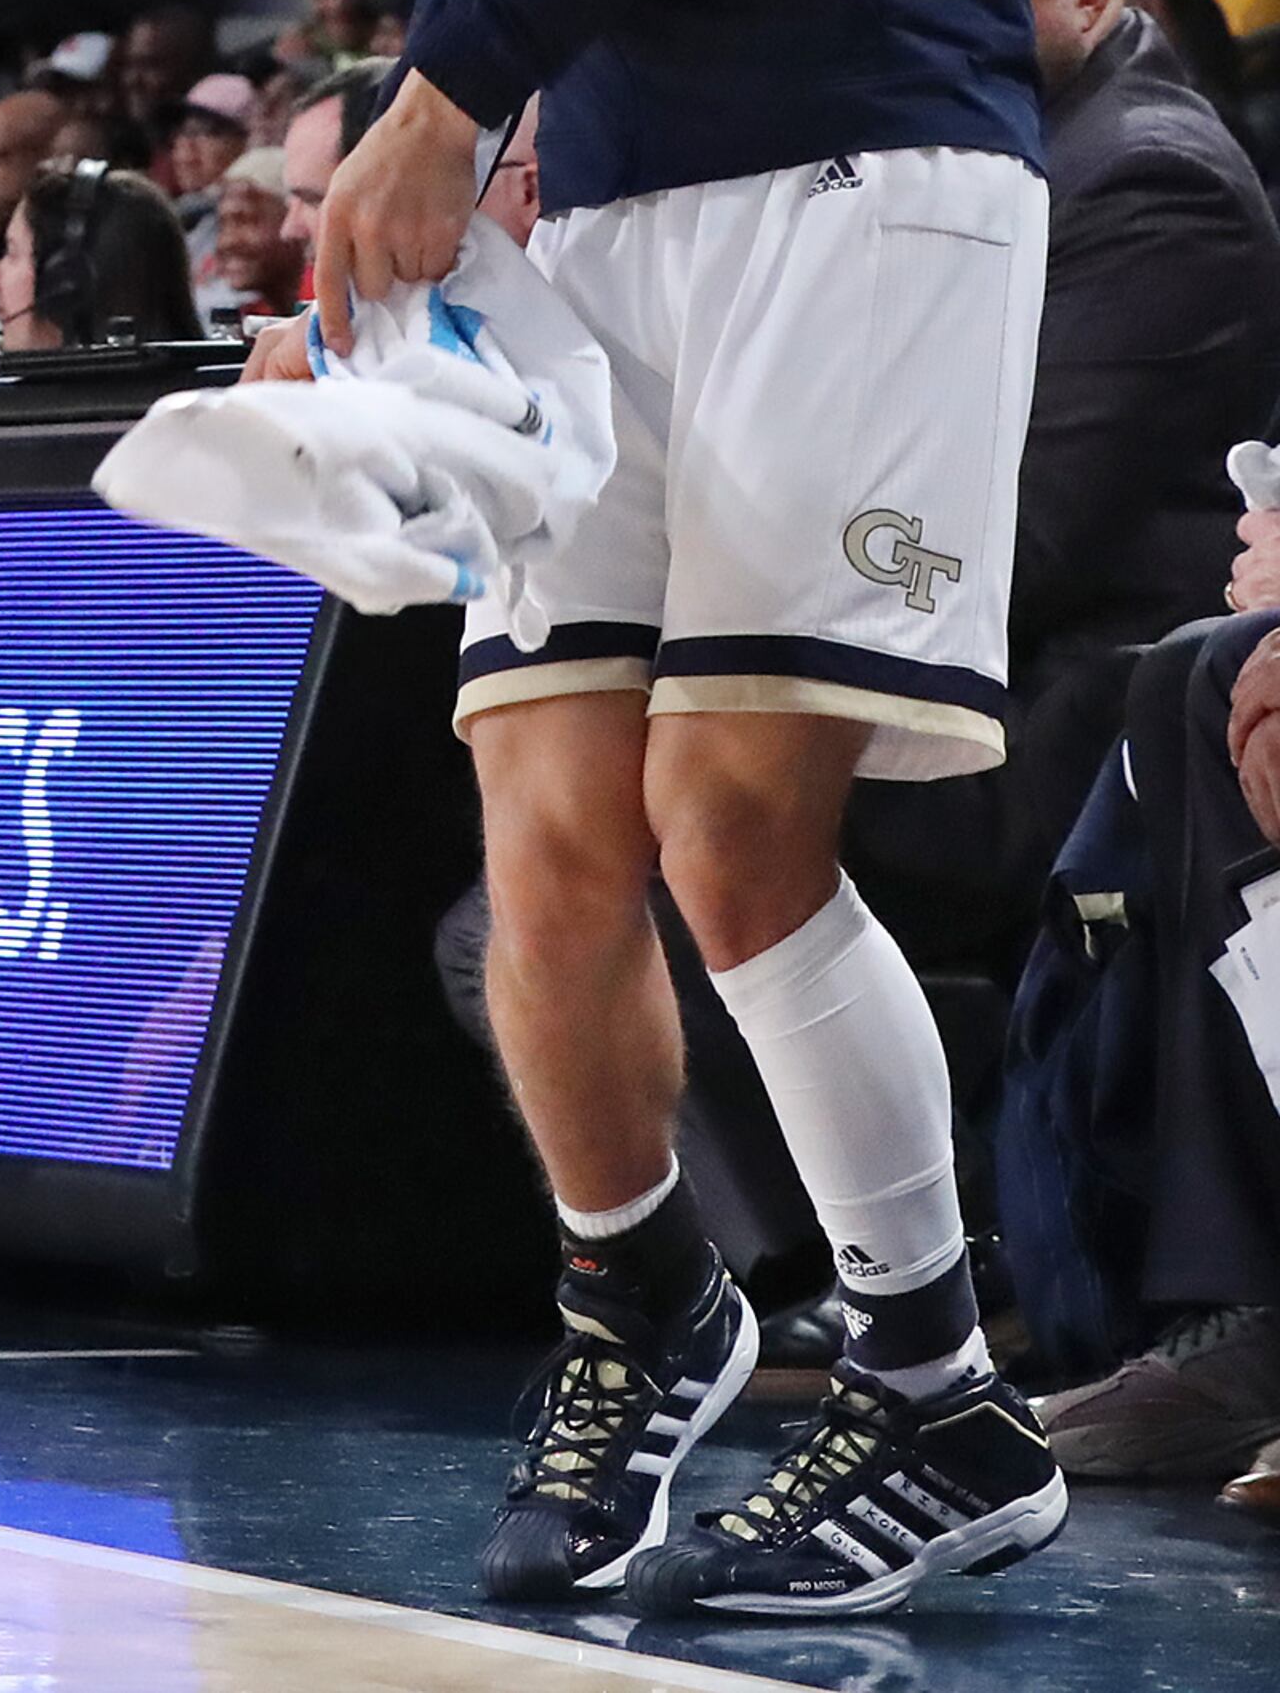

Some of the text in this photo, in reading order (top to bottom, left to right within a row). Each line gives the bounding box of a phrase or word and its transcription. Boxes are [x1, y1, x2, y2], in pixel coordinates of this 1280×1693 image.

[842, 508, 962, 614] GT
[862, 1507, 910, 1544] KOBE
[788, 1581, 812, 1592] PRO
